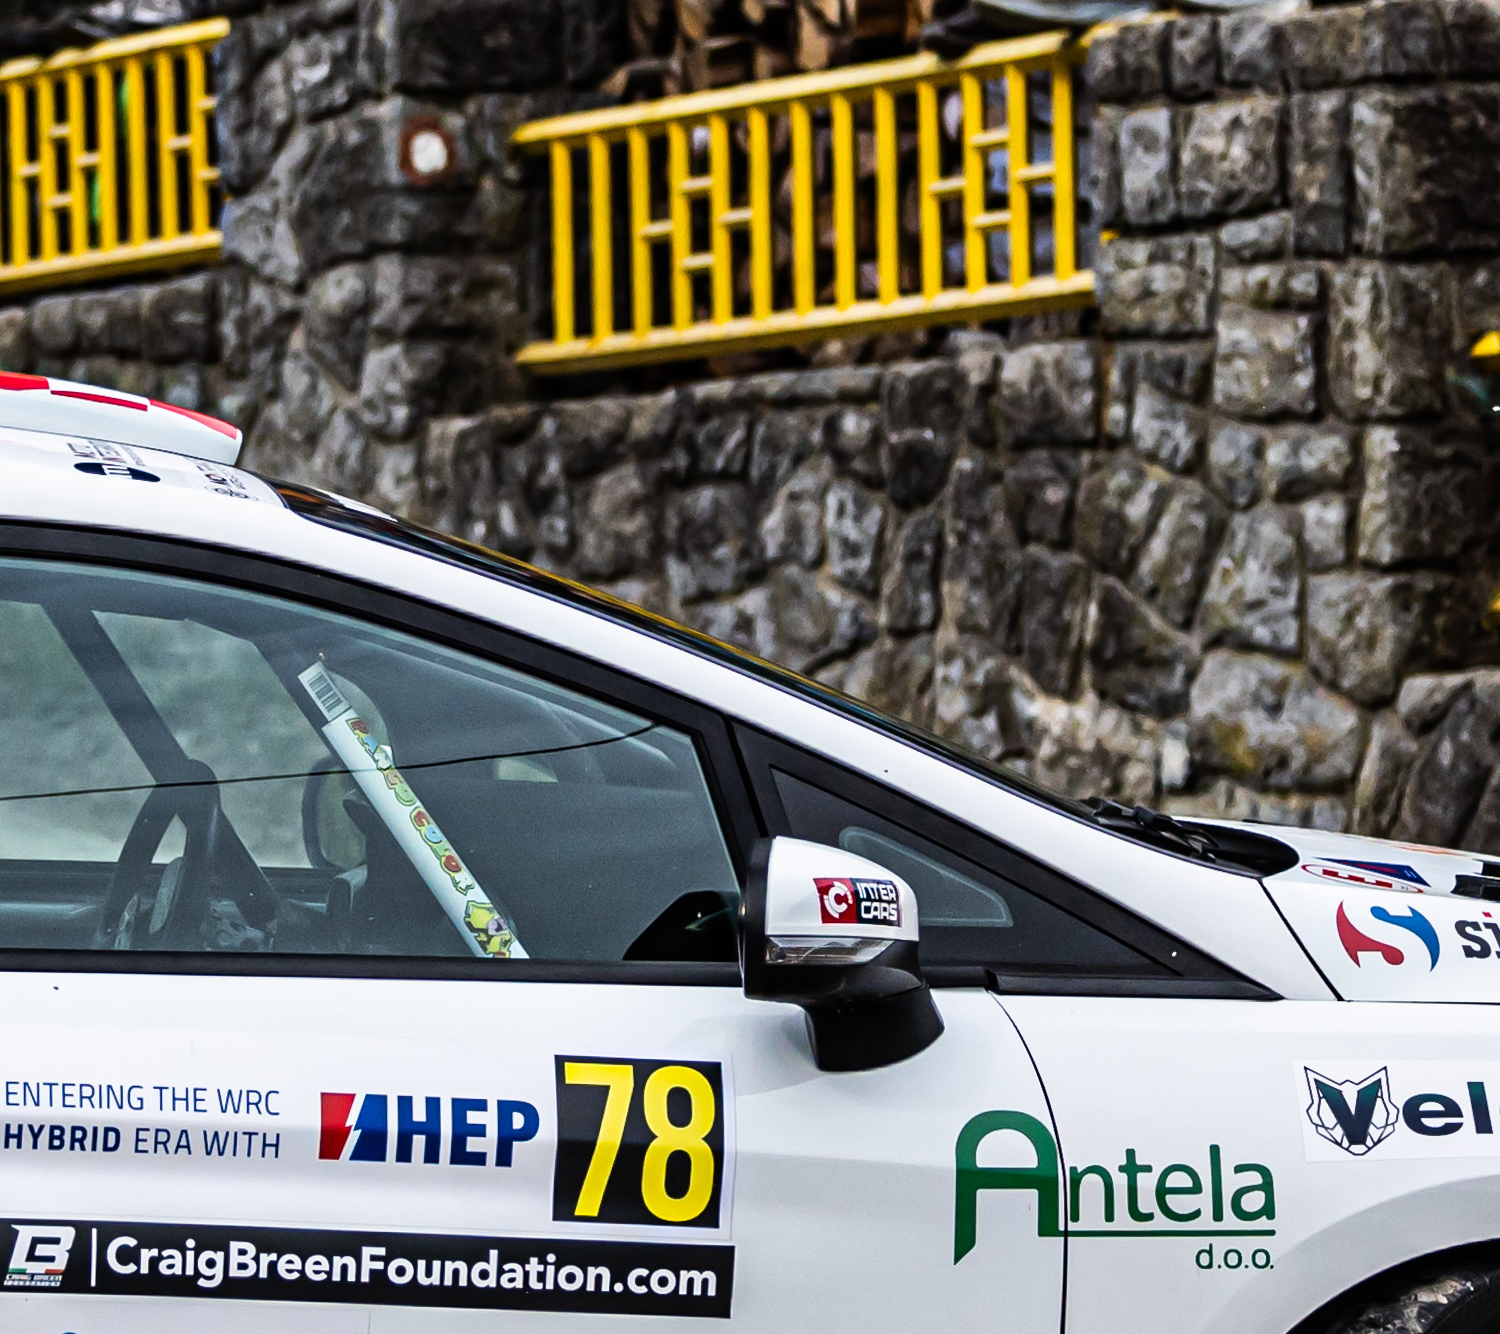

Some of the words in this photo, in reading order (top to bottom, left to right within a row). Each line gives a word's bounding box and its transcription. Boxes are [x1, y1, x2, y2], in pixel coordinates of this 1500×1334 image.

[857, 882, 896, 901] INTER
[861, 901, 898, 921] CARS
[4, 1080, 145, 1114] ENTERING
[153, 1083, 208, 1114] THE
[215, 1087, 281, 1117] WRC
[3, 1122, 122, 1153] HYBRID
[133, 1126, 192, 1156] ERA
[202, 1129, 281, 1160] WITH
[396, 1094, 540, 1168] HEP
[563, 1062, 717, 1223] 78
[954, 1109, 1276, 1266] Antela
[106, 1235, 718, 1299] CraigBreenFoundation.com
[1195, 1242, 1276, 1270] d.o.o.
